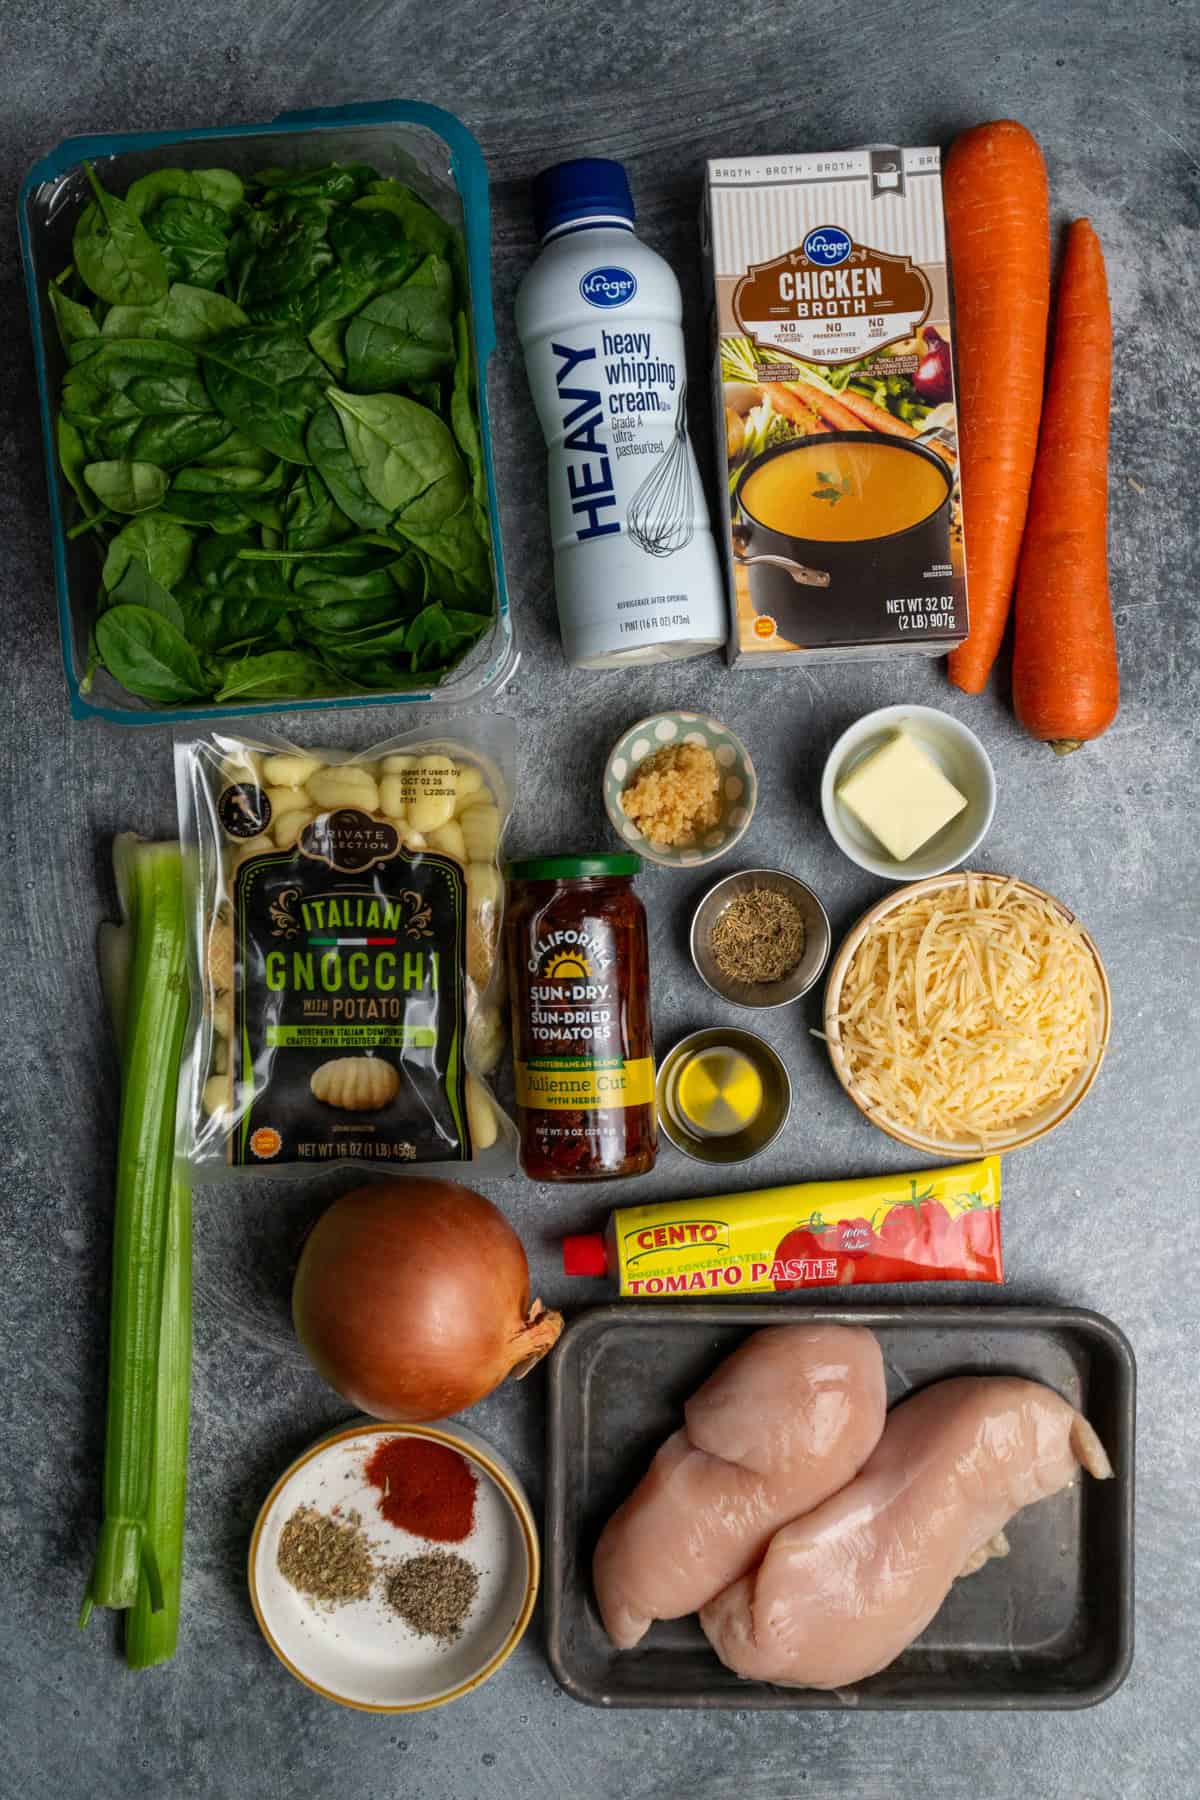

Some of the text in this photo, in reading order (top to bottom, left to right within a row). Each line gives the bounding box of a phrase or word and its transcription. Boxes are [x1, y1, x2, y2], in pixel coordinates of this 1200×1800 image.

[715, 161, 853, 178] BROTH BROTH BROTH
[807, 235, 849, 258] Kroger
[583, 275, 633, 299] Kroger
[778, 266, 883, 301] CHICKEN
[797, 300, 867, 317] BROTH
[780, 323, 796, 332] NO
[826, 323, 842, 332] NO
[868, 318, 884, 327] NO
[601, 329, 651, 359] heavy
[605, 356, 676, 391] whipping
[608, 390, 661, 415] cream
[611, 415, 644, 431] Grade A
[552, 342, 621, 541] HEAVY
[612, 428, 637, 444] ultra-
[615, 440, 664, 461] pasteurized
[886, 596, 954, 614] NET WT 32 OZ
[625, 620, 639, 633] PINT
[651, 618, 659, 628] FL
[898, 613, 956, 630] (2 LB) 907g
[400, 777, 418, 785] OCT
[451, 769, 461, 777] by
[314, 830, 385, 840] PRIVATE
[311, 841, 389, 849] SLECTION
[302, 896, 401, 931] ITALIAN
[527, 930, 612, 973] CALIFORNIA
[265, 951, 440, 993] GNOCCHI
[303, 998, 401, 1019] WITH POTATO
[530, 1011, 611, 1025] SUN-DRIED
[336, 1027, 365, 1036] ITALIAN
[531, 1026, 612, 1040] TOMATOES
[527, 1075, 627, 1092] Julienne Cut
[547, 1097, 569, 1105] WITH
[570, 1127, 583, 1137] OZ
[297, 1143, 316, 1157] NET
[317, 1143, 333, 1157] WT
[336, 1143, 348, 1157] 16
[350, 1143, 362, 1157] OZ
[636, 1223, 718, 1250] CENTO
[627, 1252, 768, 1280] DOUBLE CONCENTRATED
[627, 1266, 742, 1295] TOMATO
[751, 1258, 838, 1282] PASTE
